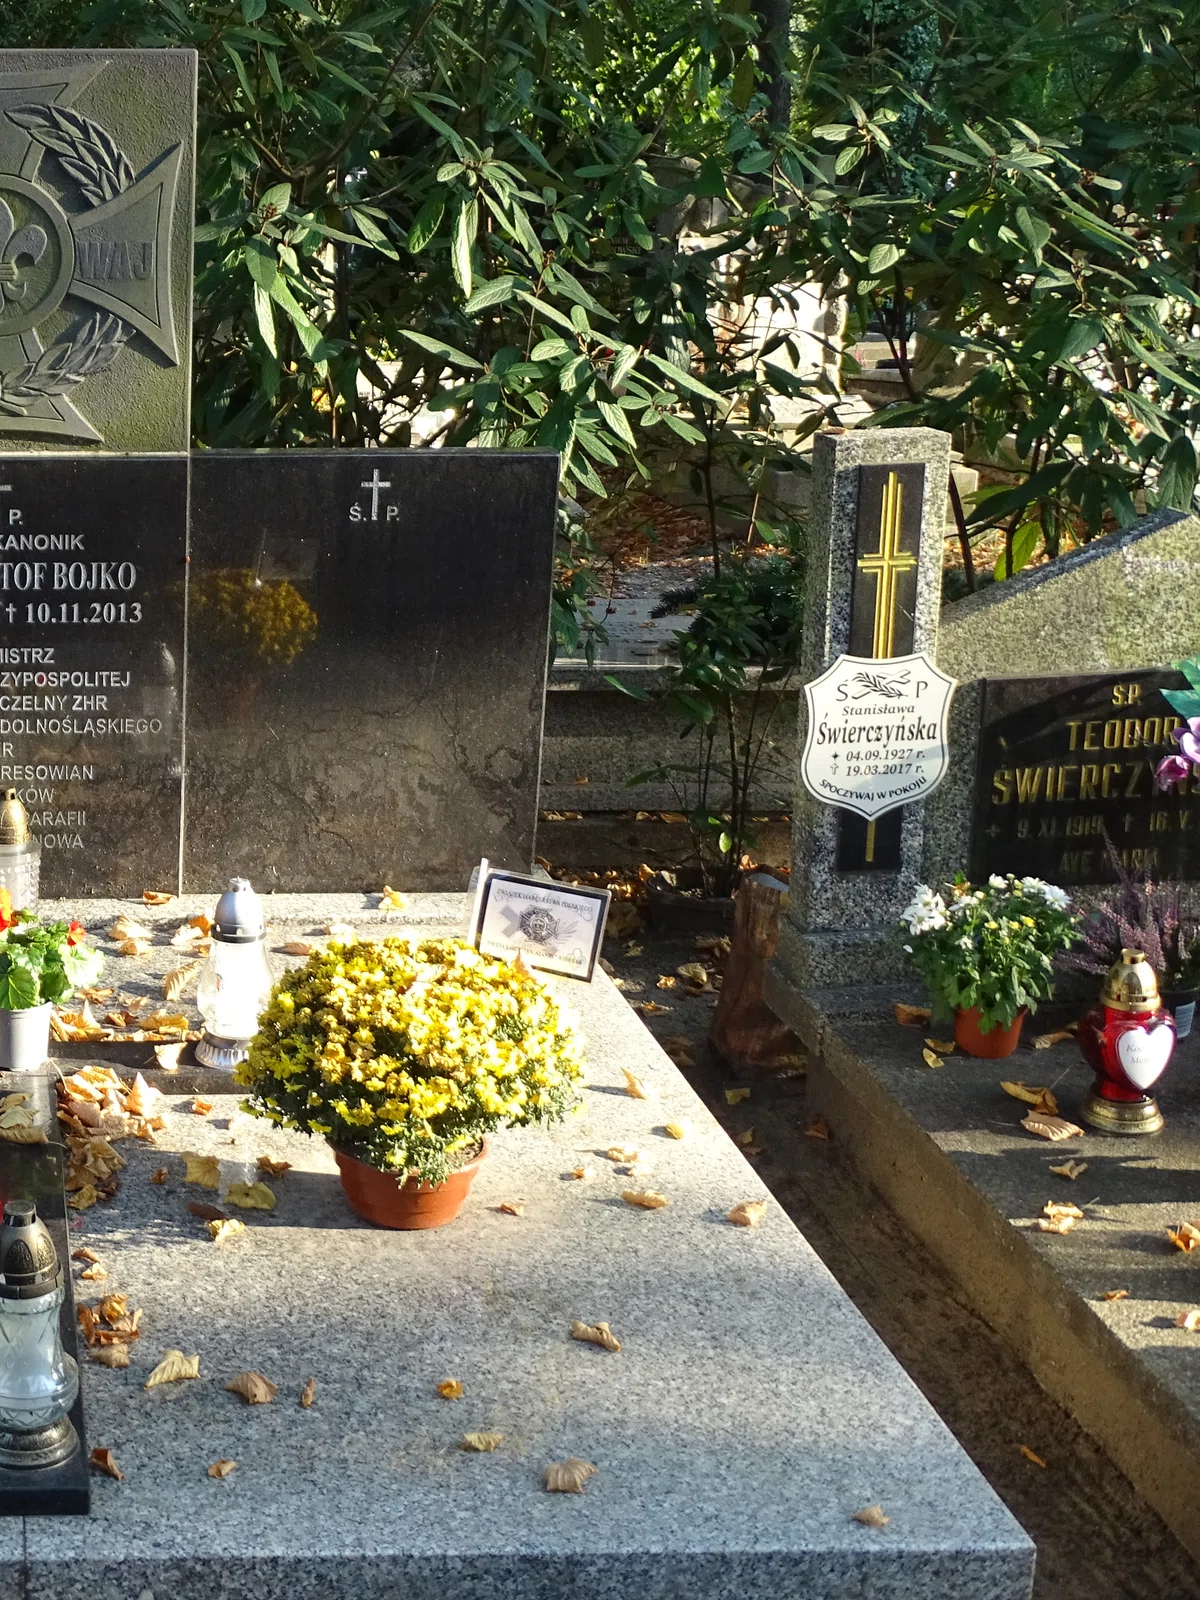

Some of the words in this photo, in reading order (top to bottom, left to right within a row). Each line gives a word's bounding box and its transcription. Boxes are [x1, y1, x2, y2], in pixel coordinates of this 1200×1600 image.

[77, 241, 153, 279] WAJ
[52, 561, 137, 590] BOJKO
[25, 602, 143, 624] 10.11.2013
[915, 681, 929, 698] P
[72, 695, 108, 711] ZHR
[841, 703, 916, 716] Stanisława
[0, 715, 162, 738] DOLNOŚLĄSKIEGO
[816, 712, 938, 748] Świerczyńska
[1066, 716, 1181, 751] TEODOR
[845, 748, 913, 762] 04.09.1927
[916, 750, 926, 759] r.
[845, 763, 912, 777] 19.03.2017
[915, 765, 924, 773] r.
[819, 779, 874, 801] SPOCZYWAJ
[876, 791, 888, 800] W
[889, 776, 928, 798] POKOJU
